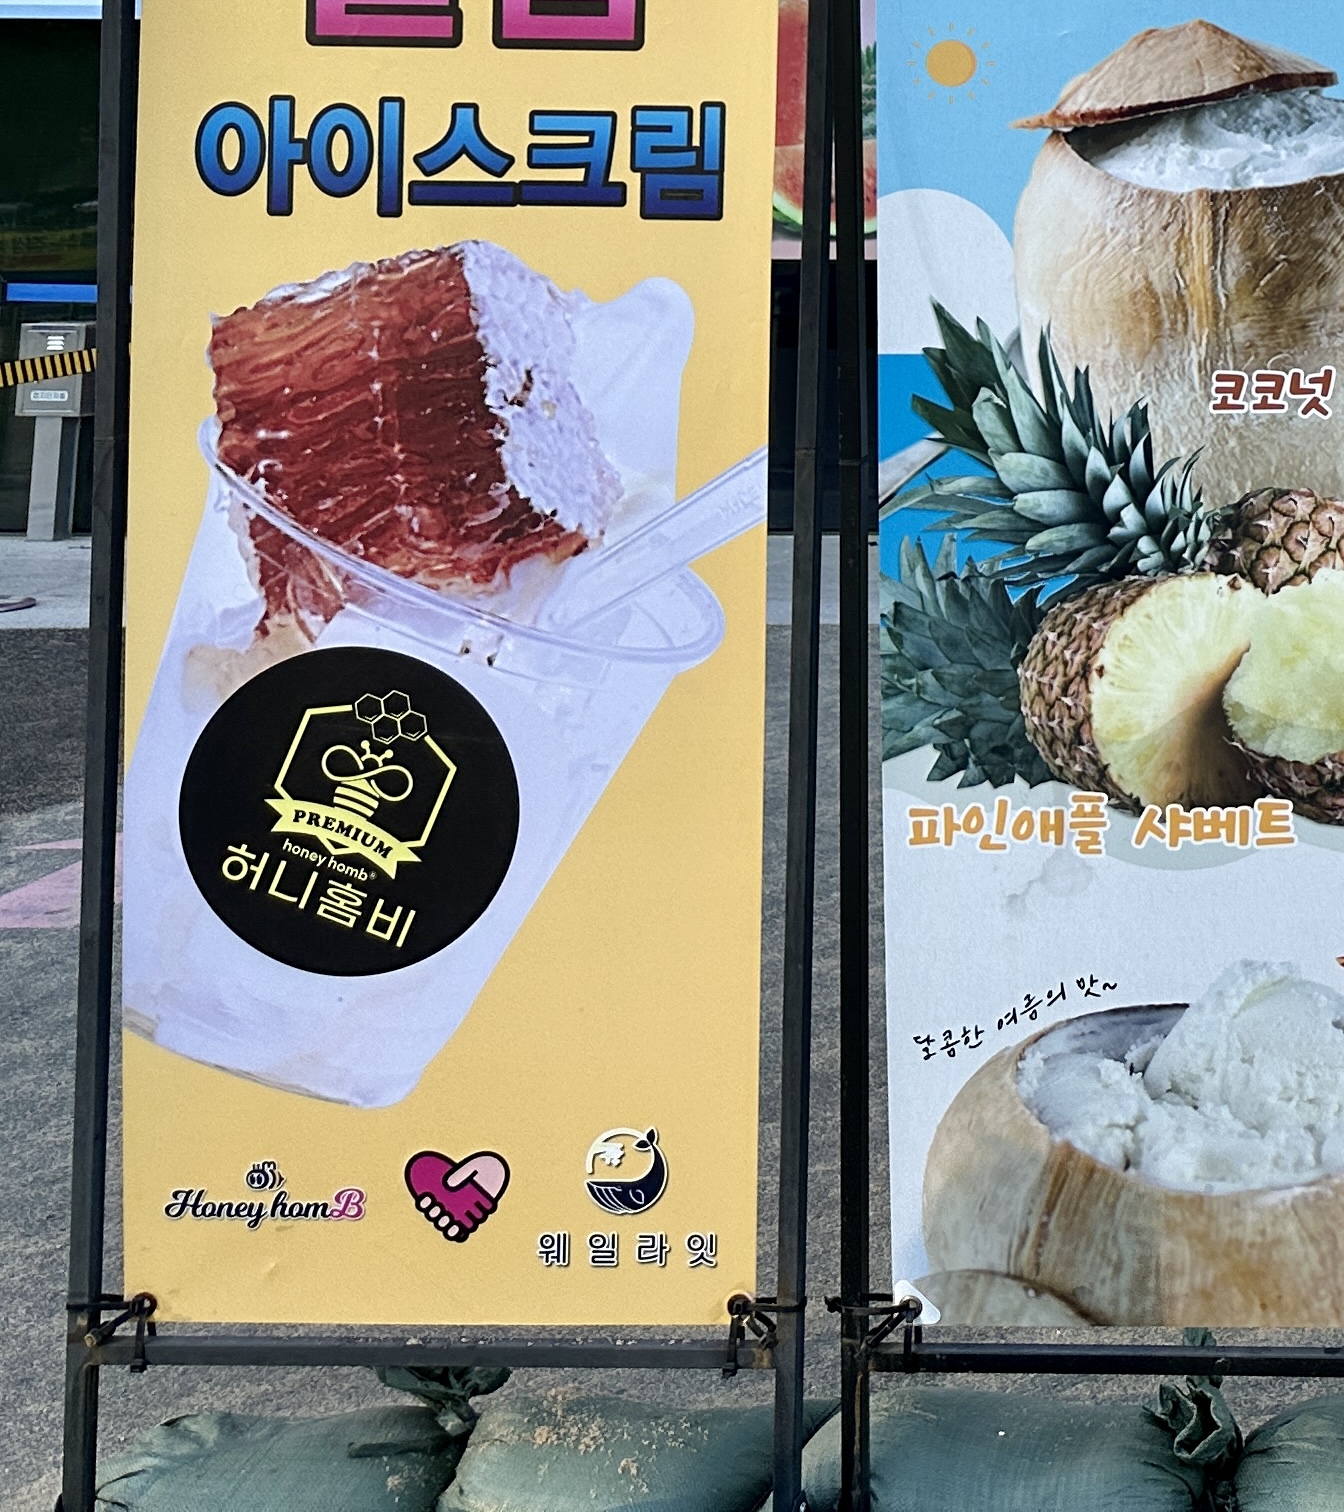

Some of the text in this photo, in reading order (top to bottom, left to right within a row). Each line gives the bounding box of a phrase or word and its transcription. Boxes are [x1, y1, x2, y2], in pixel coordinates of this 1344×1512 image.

[195, 96, 725, 220] 아이스크림
[1209, 367, 1336, 419] 코코넛
[293, 809, 393, 859] PREMIUM
[906, 792, 1299, 855] 파인애플 샤베트
[282, 838, 327, 867] honey
[221, 843, 416, 948] 허니홈비
[913, 1025, 985, 1060] 달콤한
[164, 1188, 267, 1229] Honey
[537, 1232, 718, 1268] 웨일라잇
